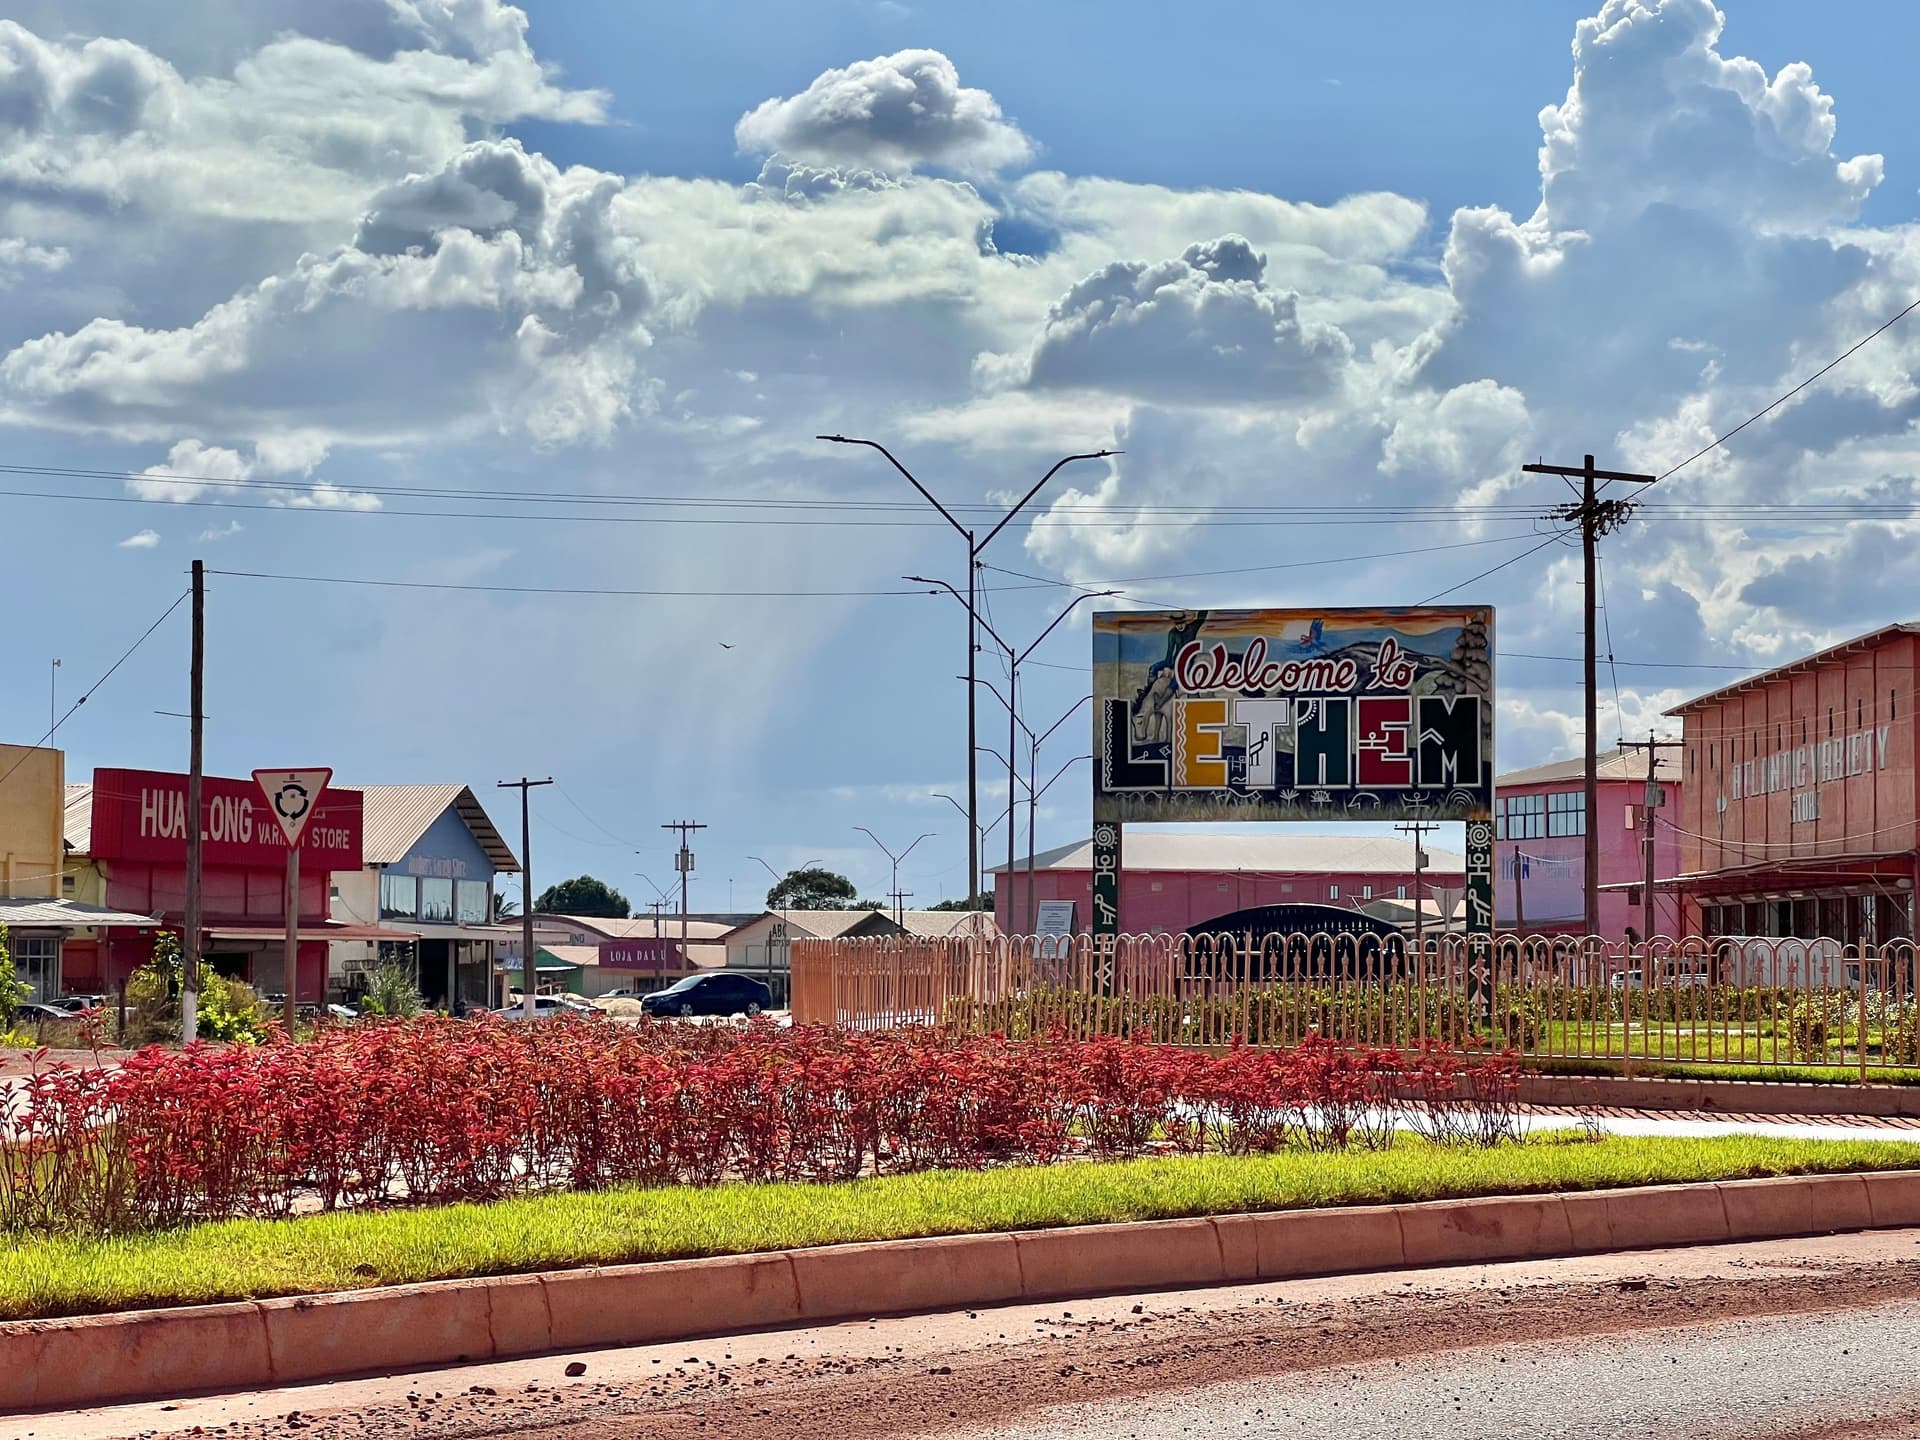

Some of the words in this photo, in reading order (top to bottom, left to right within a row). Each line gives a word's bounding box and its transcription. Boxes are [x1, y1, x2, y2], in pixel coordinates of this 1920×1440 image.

[1175, 635, 1358, 692] Welcome
[1365, 634, 1418, 691] to
[1102, 694, 1483, 792] LETHEM
[1733, 747, 1806, 800] ATLANTIC
[1810, 726, 1889, 783] VARIETY
[141, 788, 187, 839] HUA
[201, 795, 253, 843] ONG
[312, 827, 350, 849] STORE
[610, 950, 632, 962] LOJA
